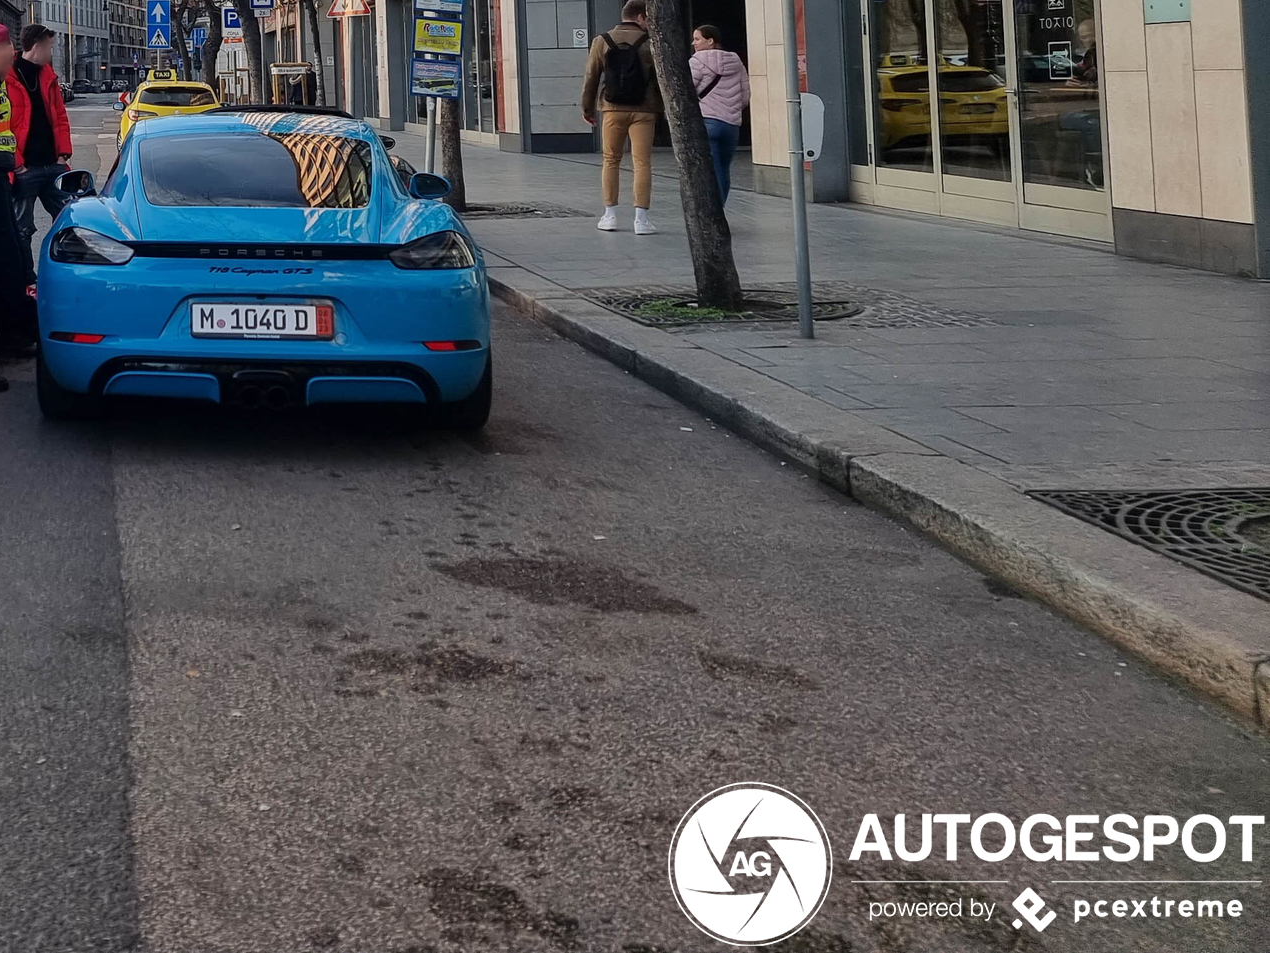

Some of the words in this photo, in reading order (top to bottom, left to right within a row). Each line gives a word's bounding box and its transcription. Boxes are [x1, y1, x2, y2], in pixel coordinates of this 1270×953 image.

[200, 248, 323, 256] PORSCHE
[231, 267, 279, 276] Cayman
[200, 308, 214, 330] M
[230, 308, 287, 331] 1040
[294, 309, 309, 331] D
